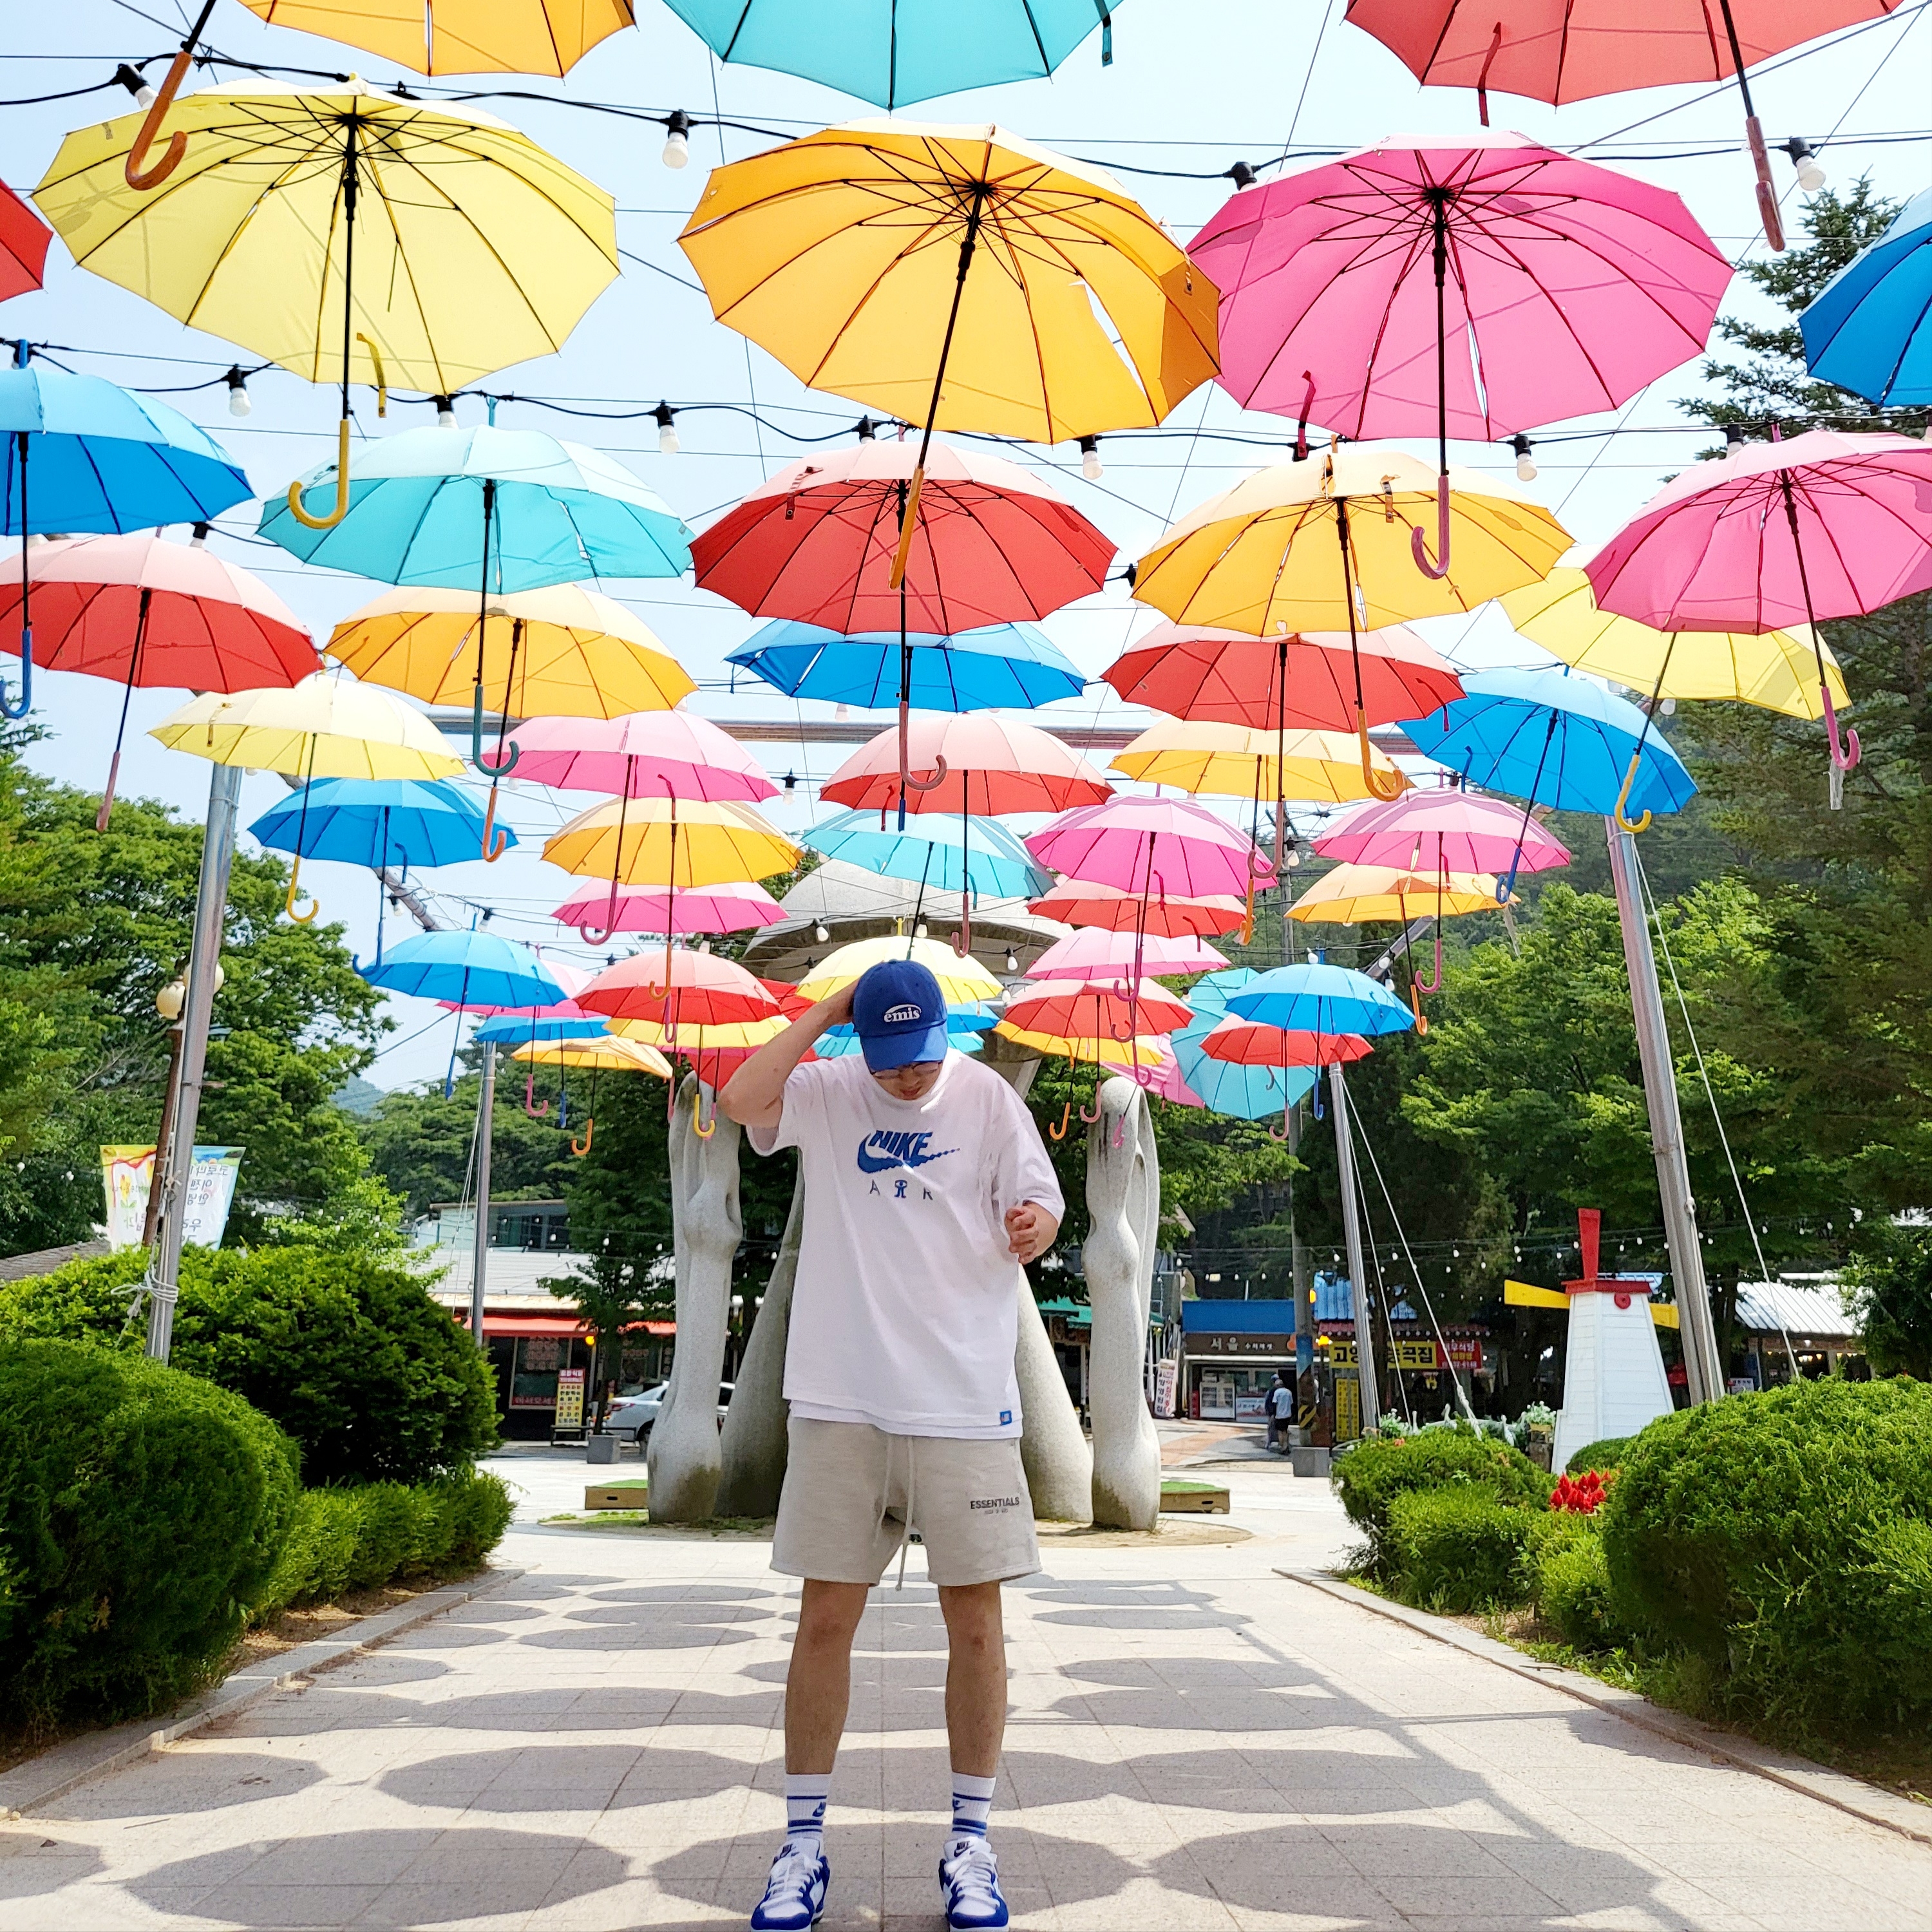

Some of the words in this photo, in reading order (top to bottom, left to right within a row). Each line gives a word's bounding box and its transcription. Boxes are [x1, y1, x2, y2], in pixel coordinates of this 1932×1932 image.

[884, 1007, 920, 1023] emis
[868, 1130, 933, 1160] NIKE
[970, 1496, 1019, 1510] ESSENTIALS
